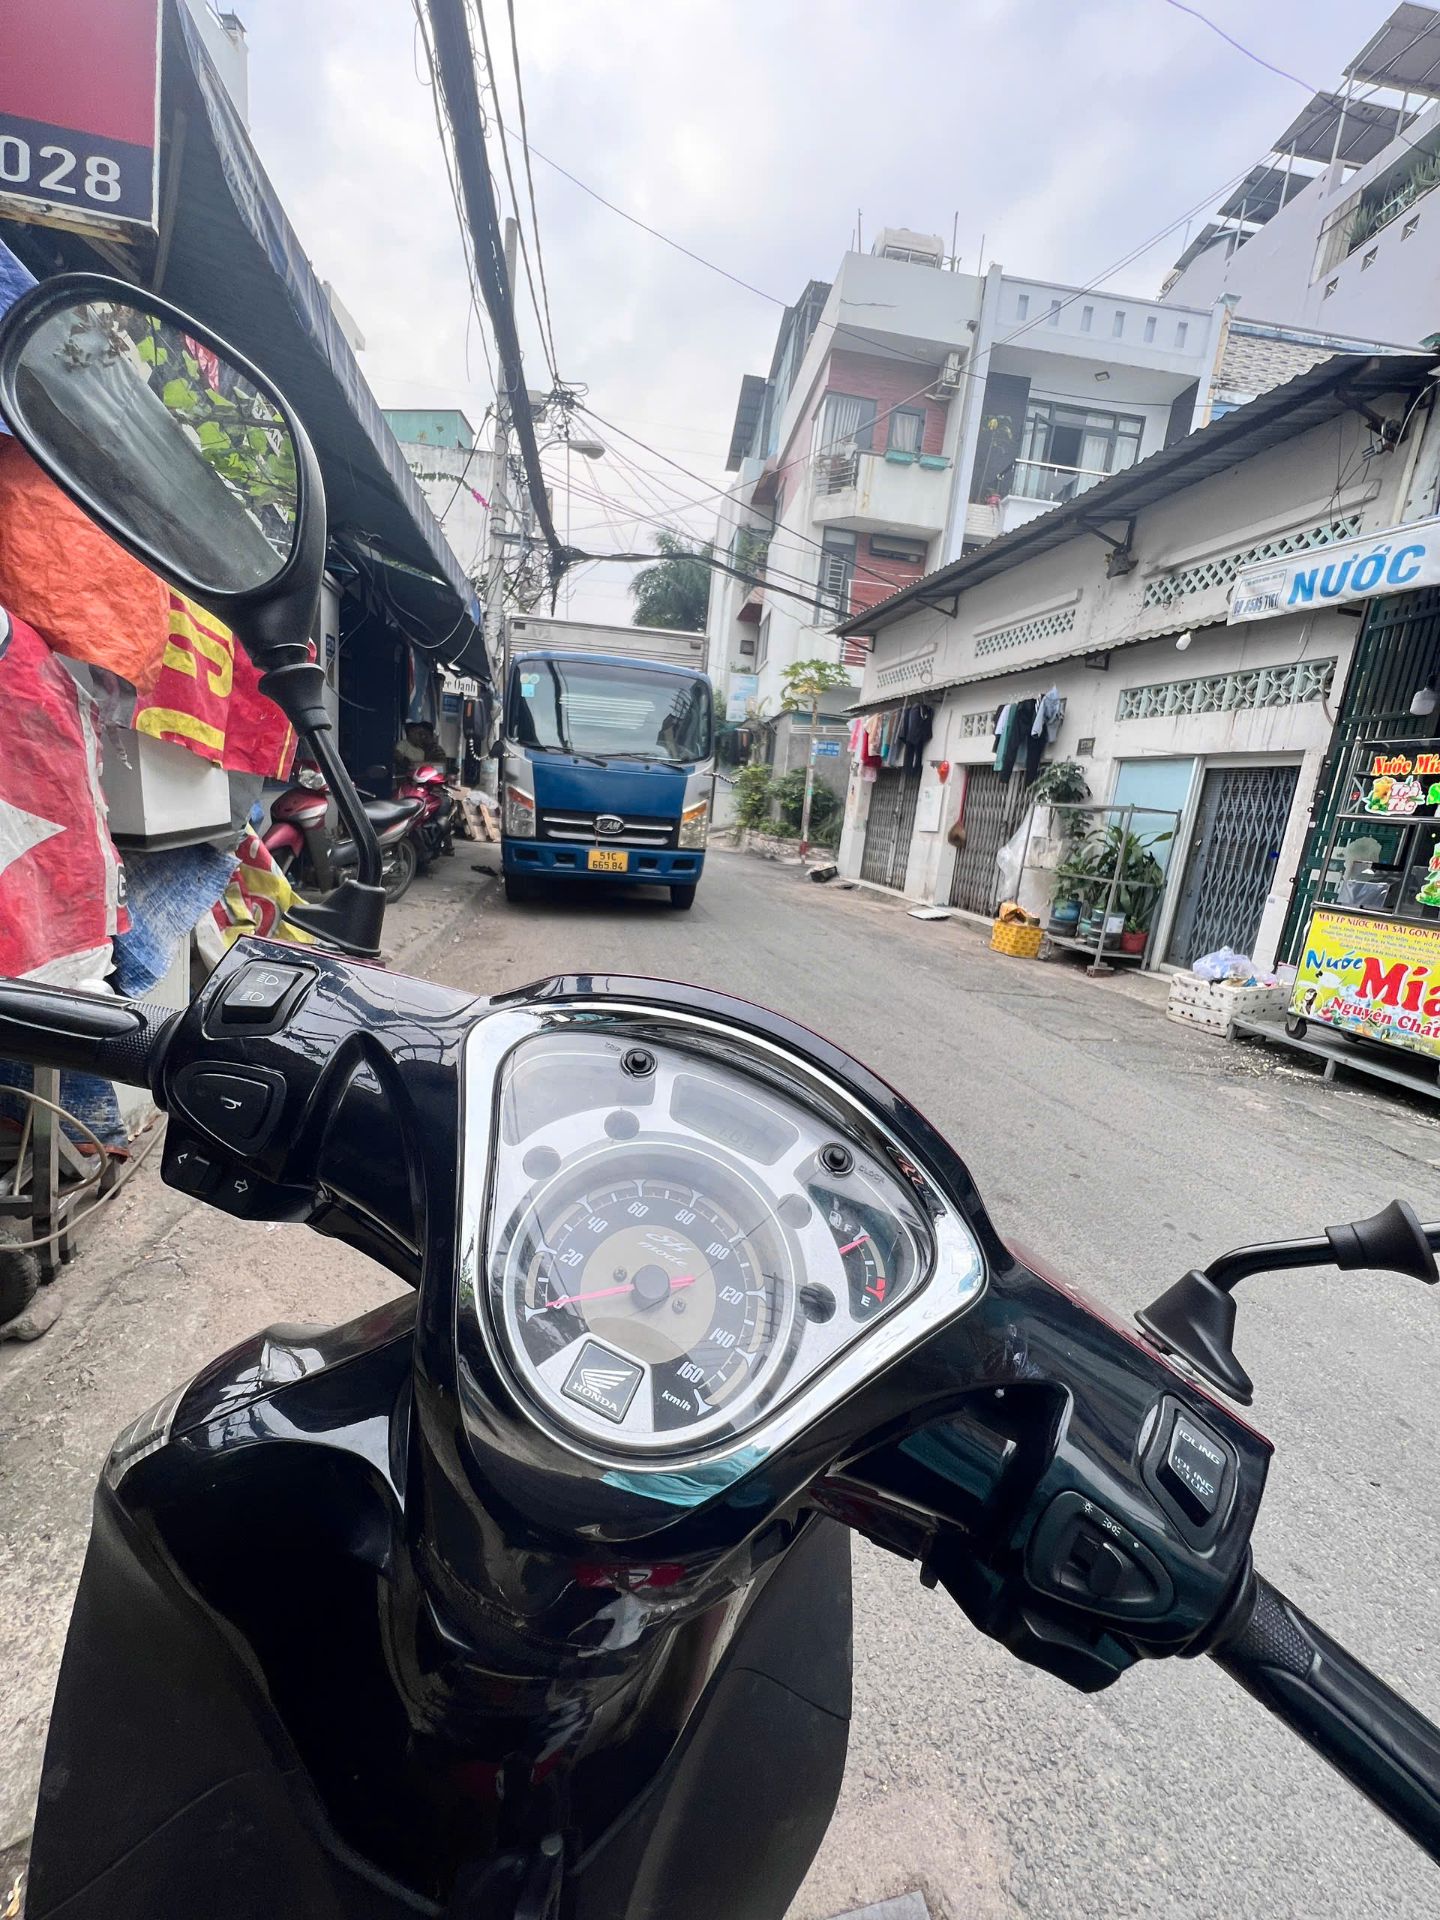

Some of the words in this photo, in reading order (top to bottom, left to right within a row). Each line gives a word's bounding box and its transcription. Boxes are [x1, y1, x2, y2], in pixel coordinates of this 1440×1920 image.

[0, 135, 121, 202] 028
[1287, 544, 1426, 605] NƯỚC
[1370, 754, 1413, 776] Nước
[592, 860, 623, 871] 665.84
[599, 851, 617, 861] 51C
[1306, 949, 1363, 971] Nước
[1331, 997, 1392, 1025] Nguyên
[1398, 1015, 1440, 1038] Chất
[627, 1201, 649, 1217] 60
[674, 1208, 697, 1225] 80
[587, 1215, 609, 1233] 40
[843, 1223, 853, 1232] F
[560, 1248, 585, 1267] 20
[704, 1242, 730, 1260] 100
[718, 1285, 744, 1305] 120
[860, 1294, 871, 1307] E
[708, 1327, 736, 1349] 140
[676, 1361, 705, 1384] 160
[572, 1381, 618, 1412] HONDA
[661, 1390, 692, 1411] km/h
[1178, 1429, 1220, 1465] IDLING
